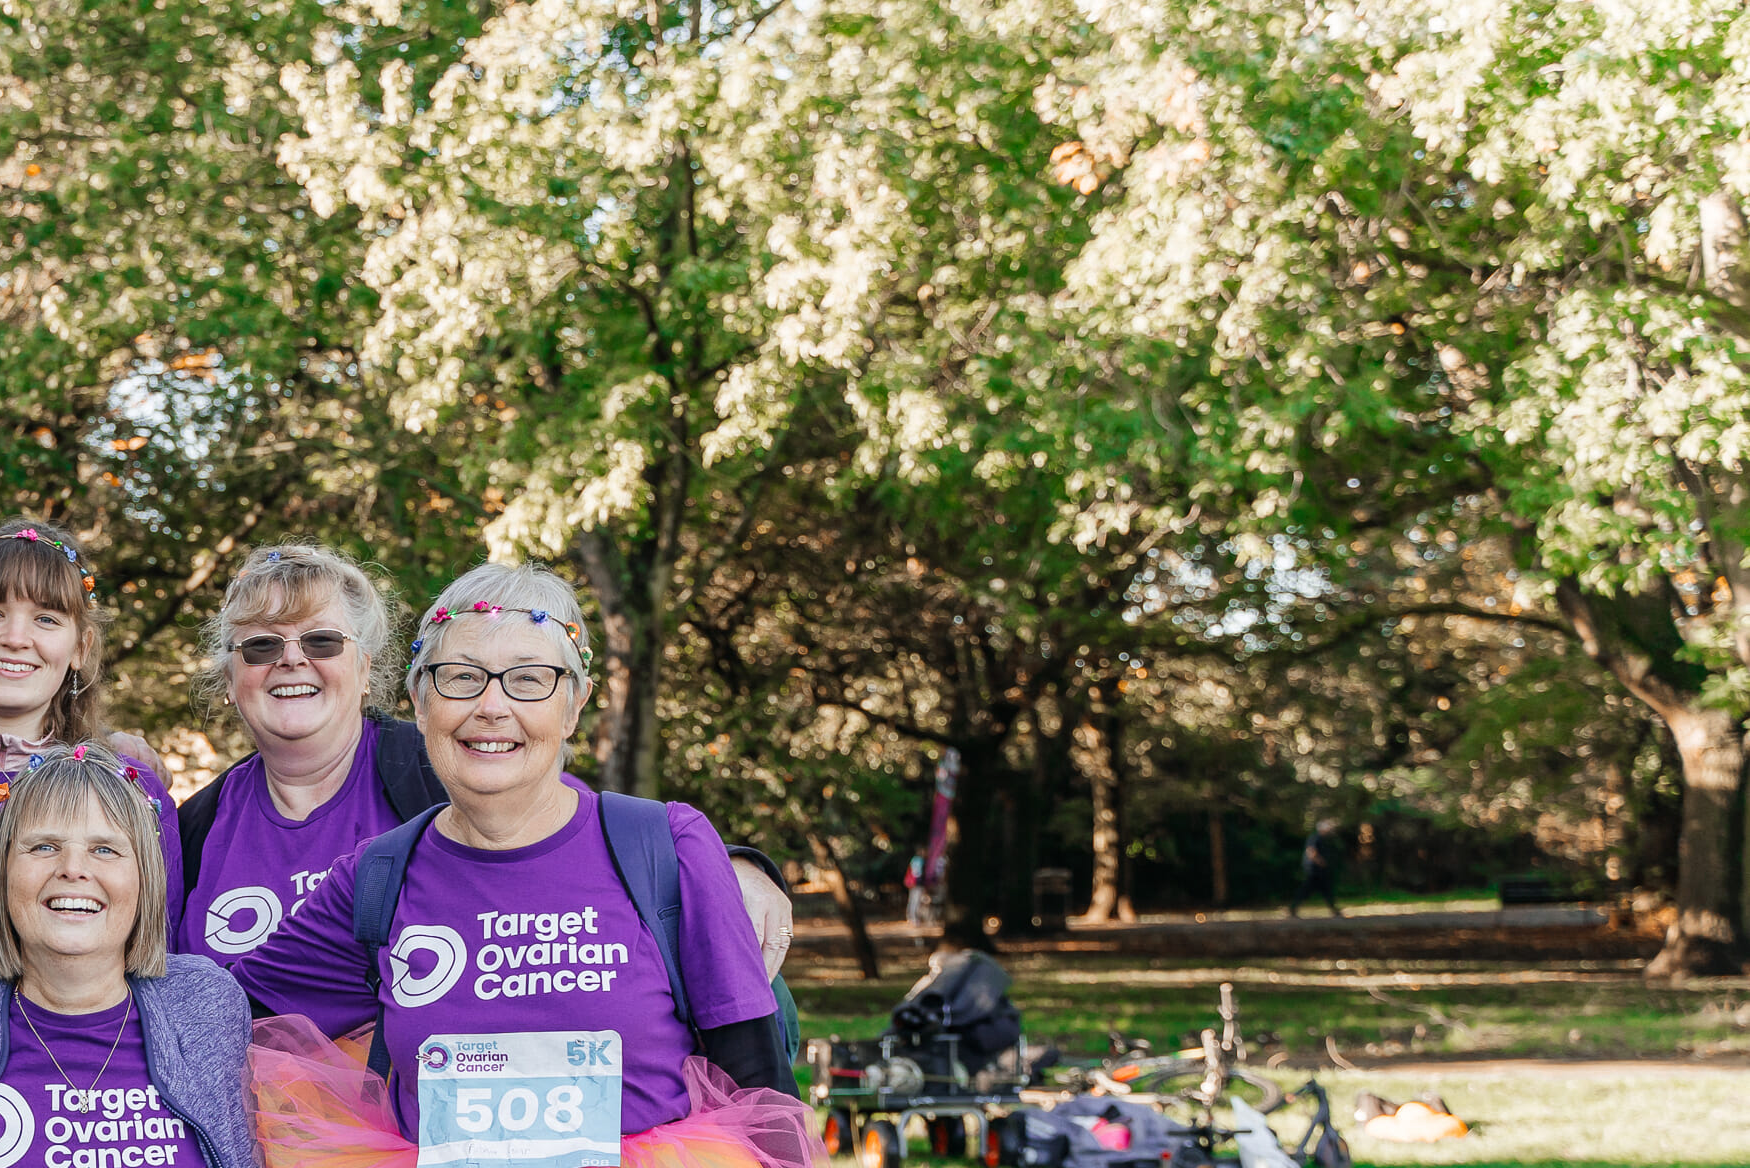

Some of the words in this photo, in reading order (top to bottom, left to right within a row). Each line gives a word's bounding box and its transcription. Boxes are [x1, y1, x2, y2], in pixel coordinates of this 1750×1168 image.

[477, 906, 599, 942] Target
[476, 938, 629, 973] Ovarian
[474, 966, 617, 1001] Cancer
[455, 1040, 499, 1054] Target
[456, 1051, 509, 1063] Ovarian
[566, 1039, 612, 1067] 5K
[456, 1062, 505, 1073] Cancer
[44, 1084, 161, 1120] Target
[455, 1085, 585, 1133] 508
[44, 1112, 186, 1144] Ovarian
